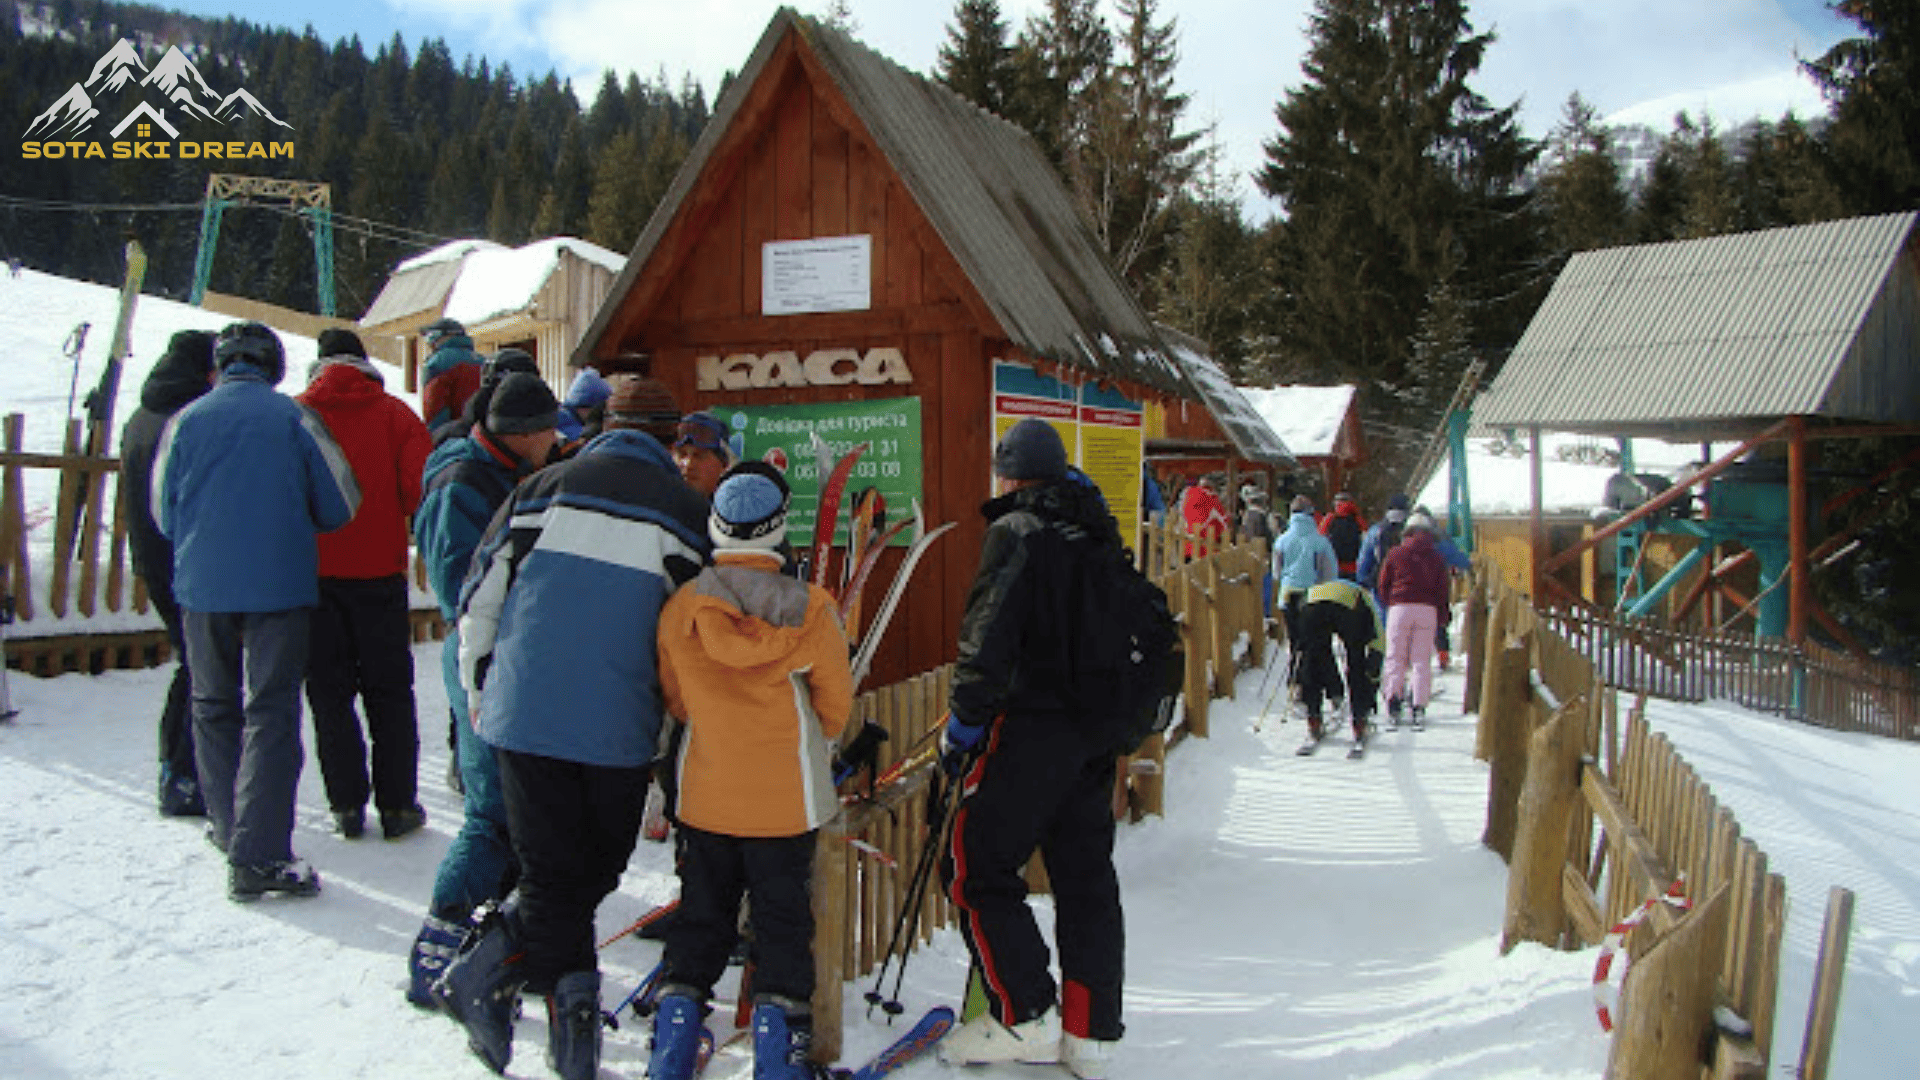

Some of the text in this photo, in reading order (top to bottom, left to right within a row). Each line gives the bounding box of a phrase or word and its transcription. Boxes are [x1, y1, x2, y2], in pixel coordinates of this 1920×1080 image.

[696, 348, 913, 390] КАСА
[848, 412, 907, 432] туриста
[857, 462, 877, 478] 03
